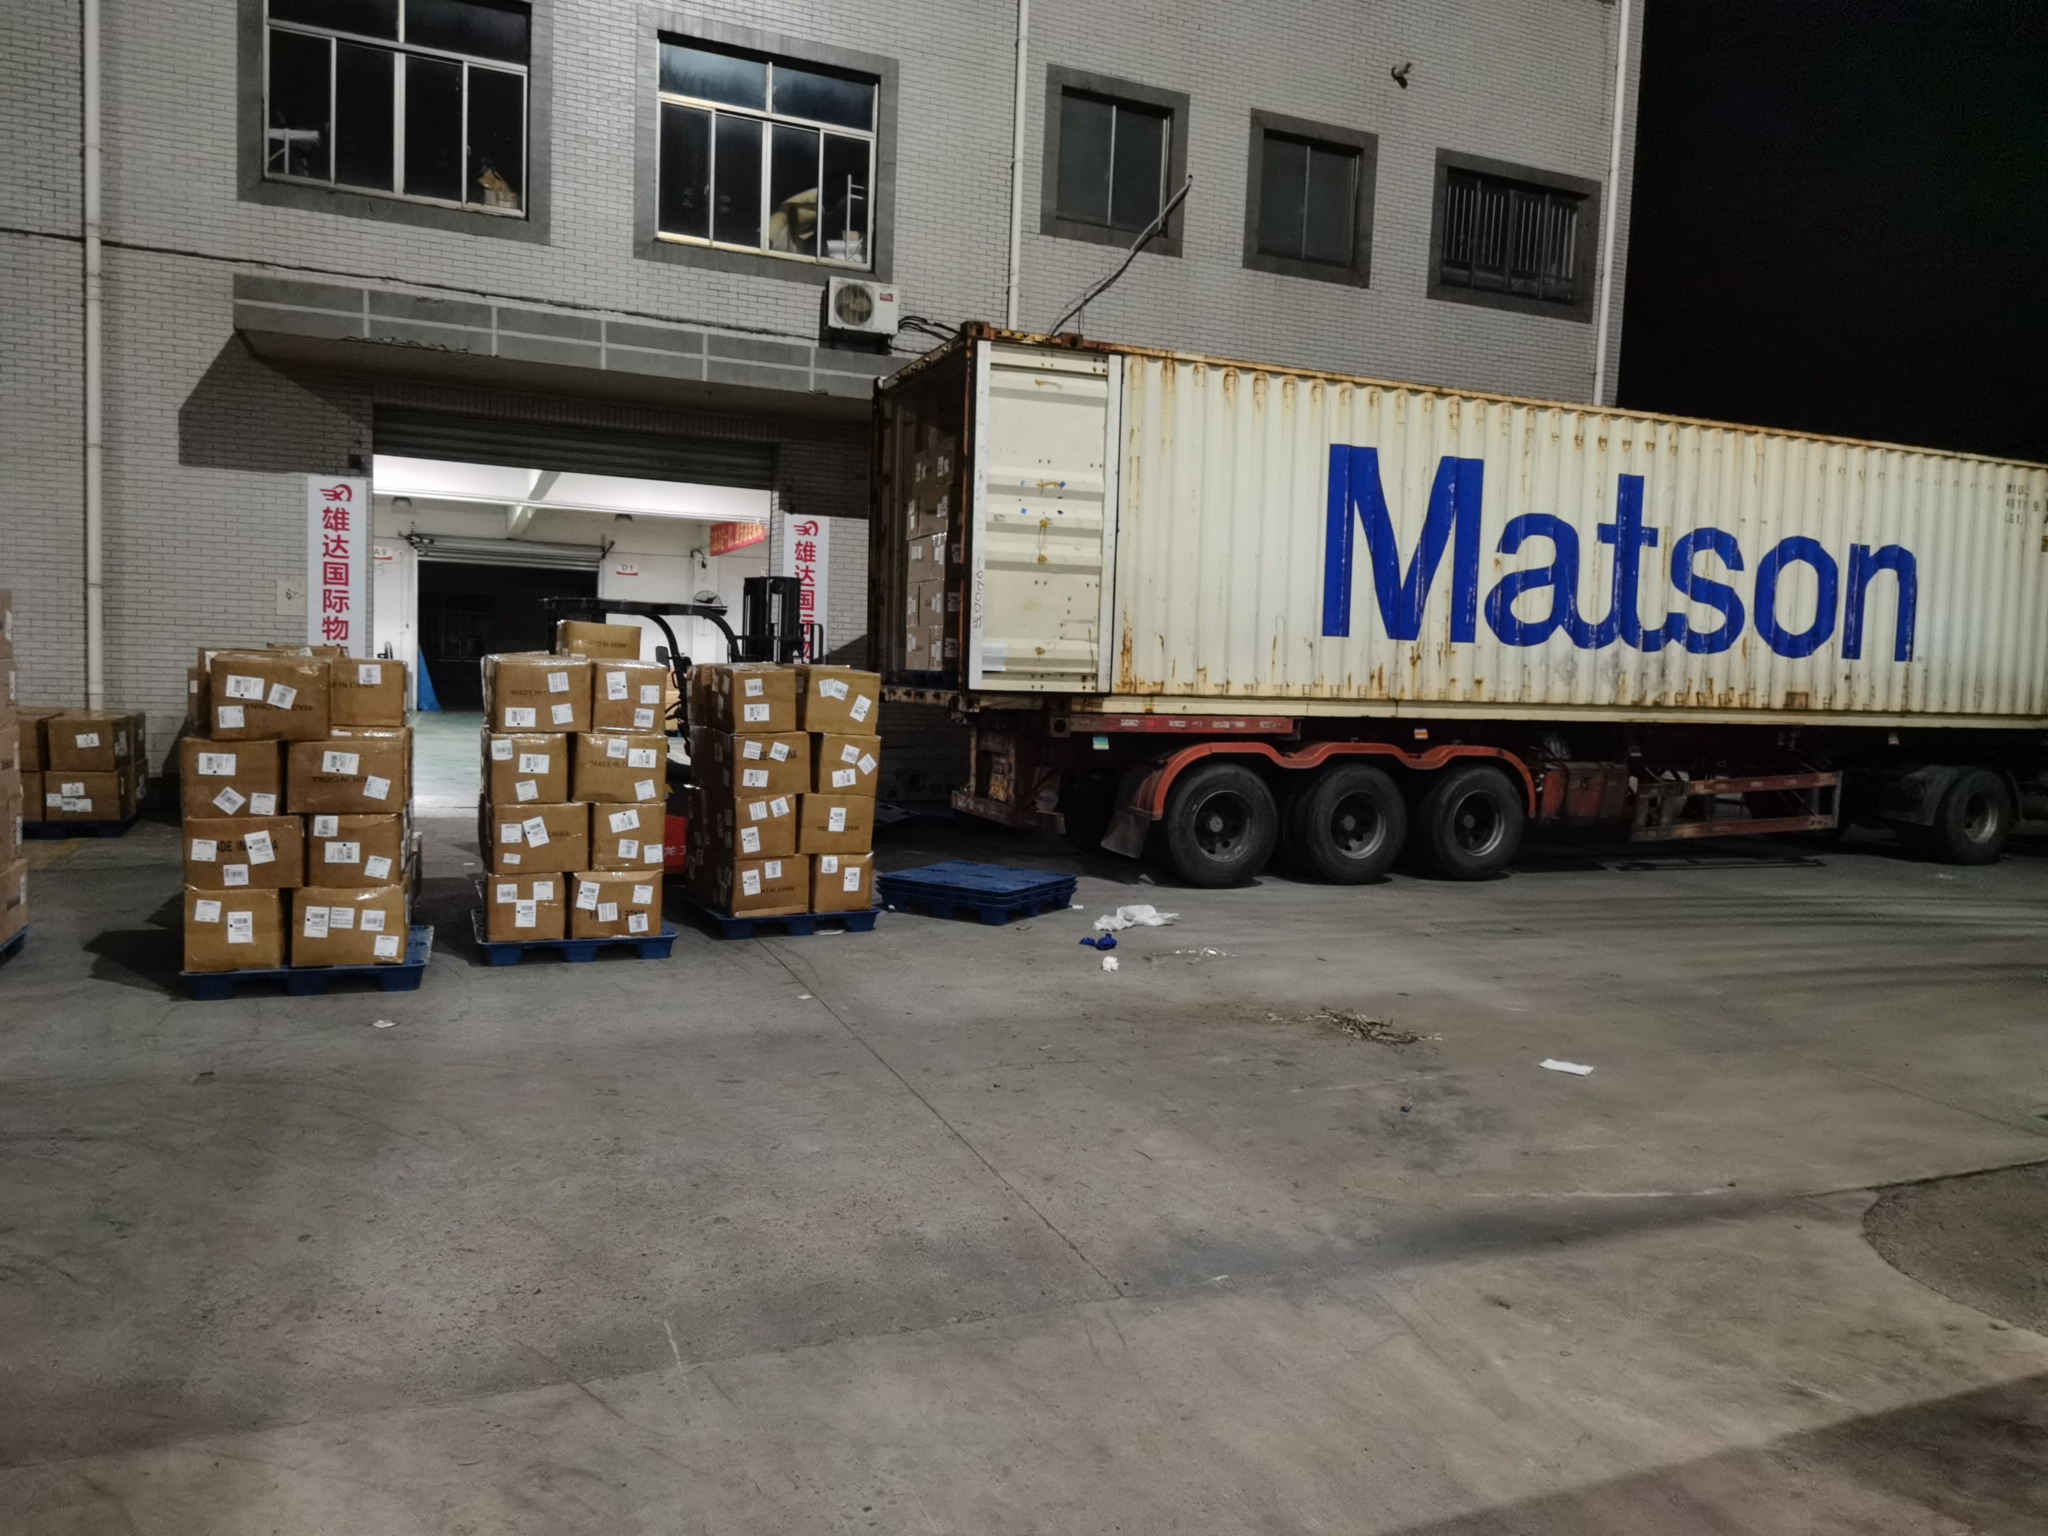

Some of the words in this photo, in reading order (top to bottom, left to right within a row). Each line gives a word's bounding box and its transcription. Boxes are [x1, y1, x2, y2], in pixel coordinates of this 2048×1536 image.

[321, 506, 351, 653] 雄达国际物
[1322, 443, 1917, 662] Matson
